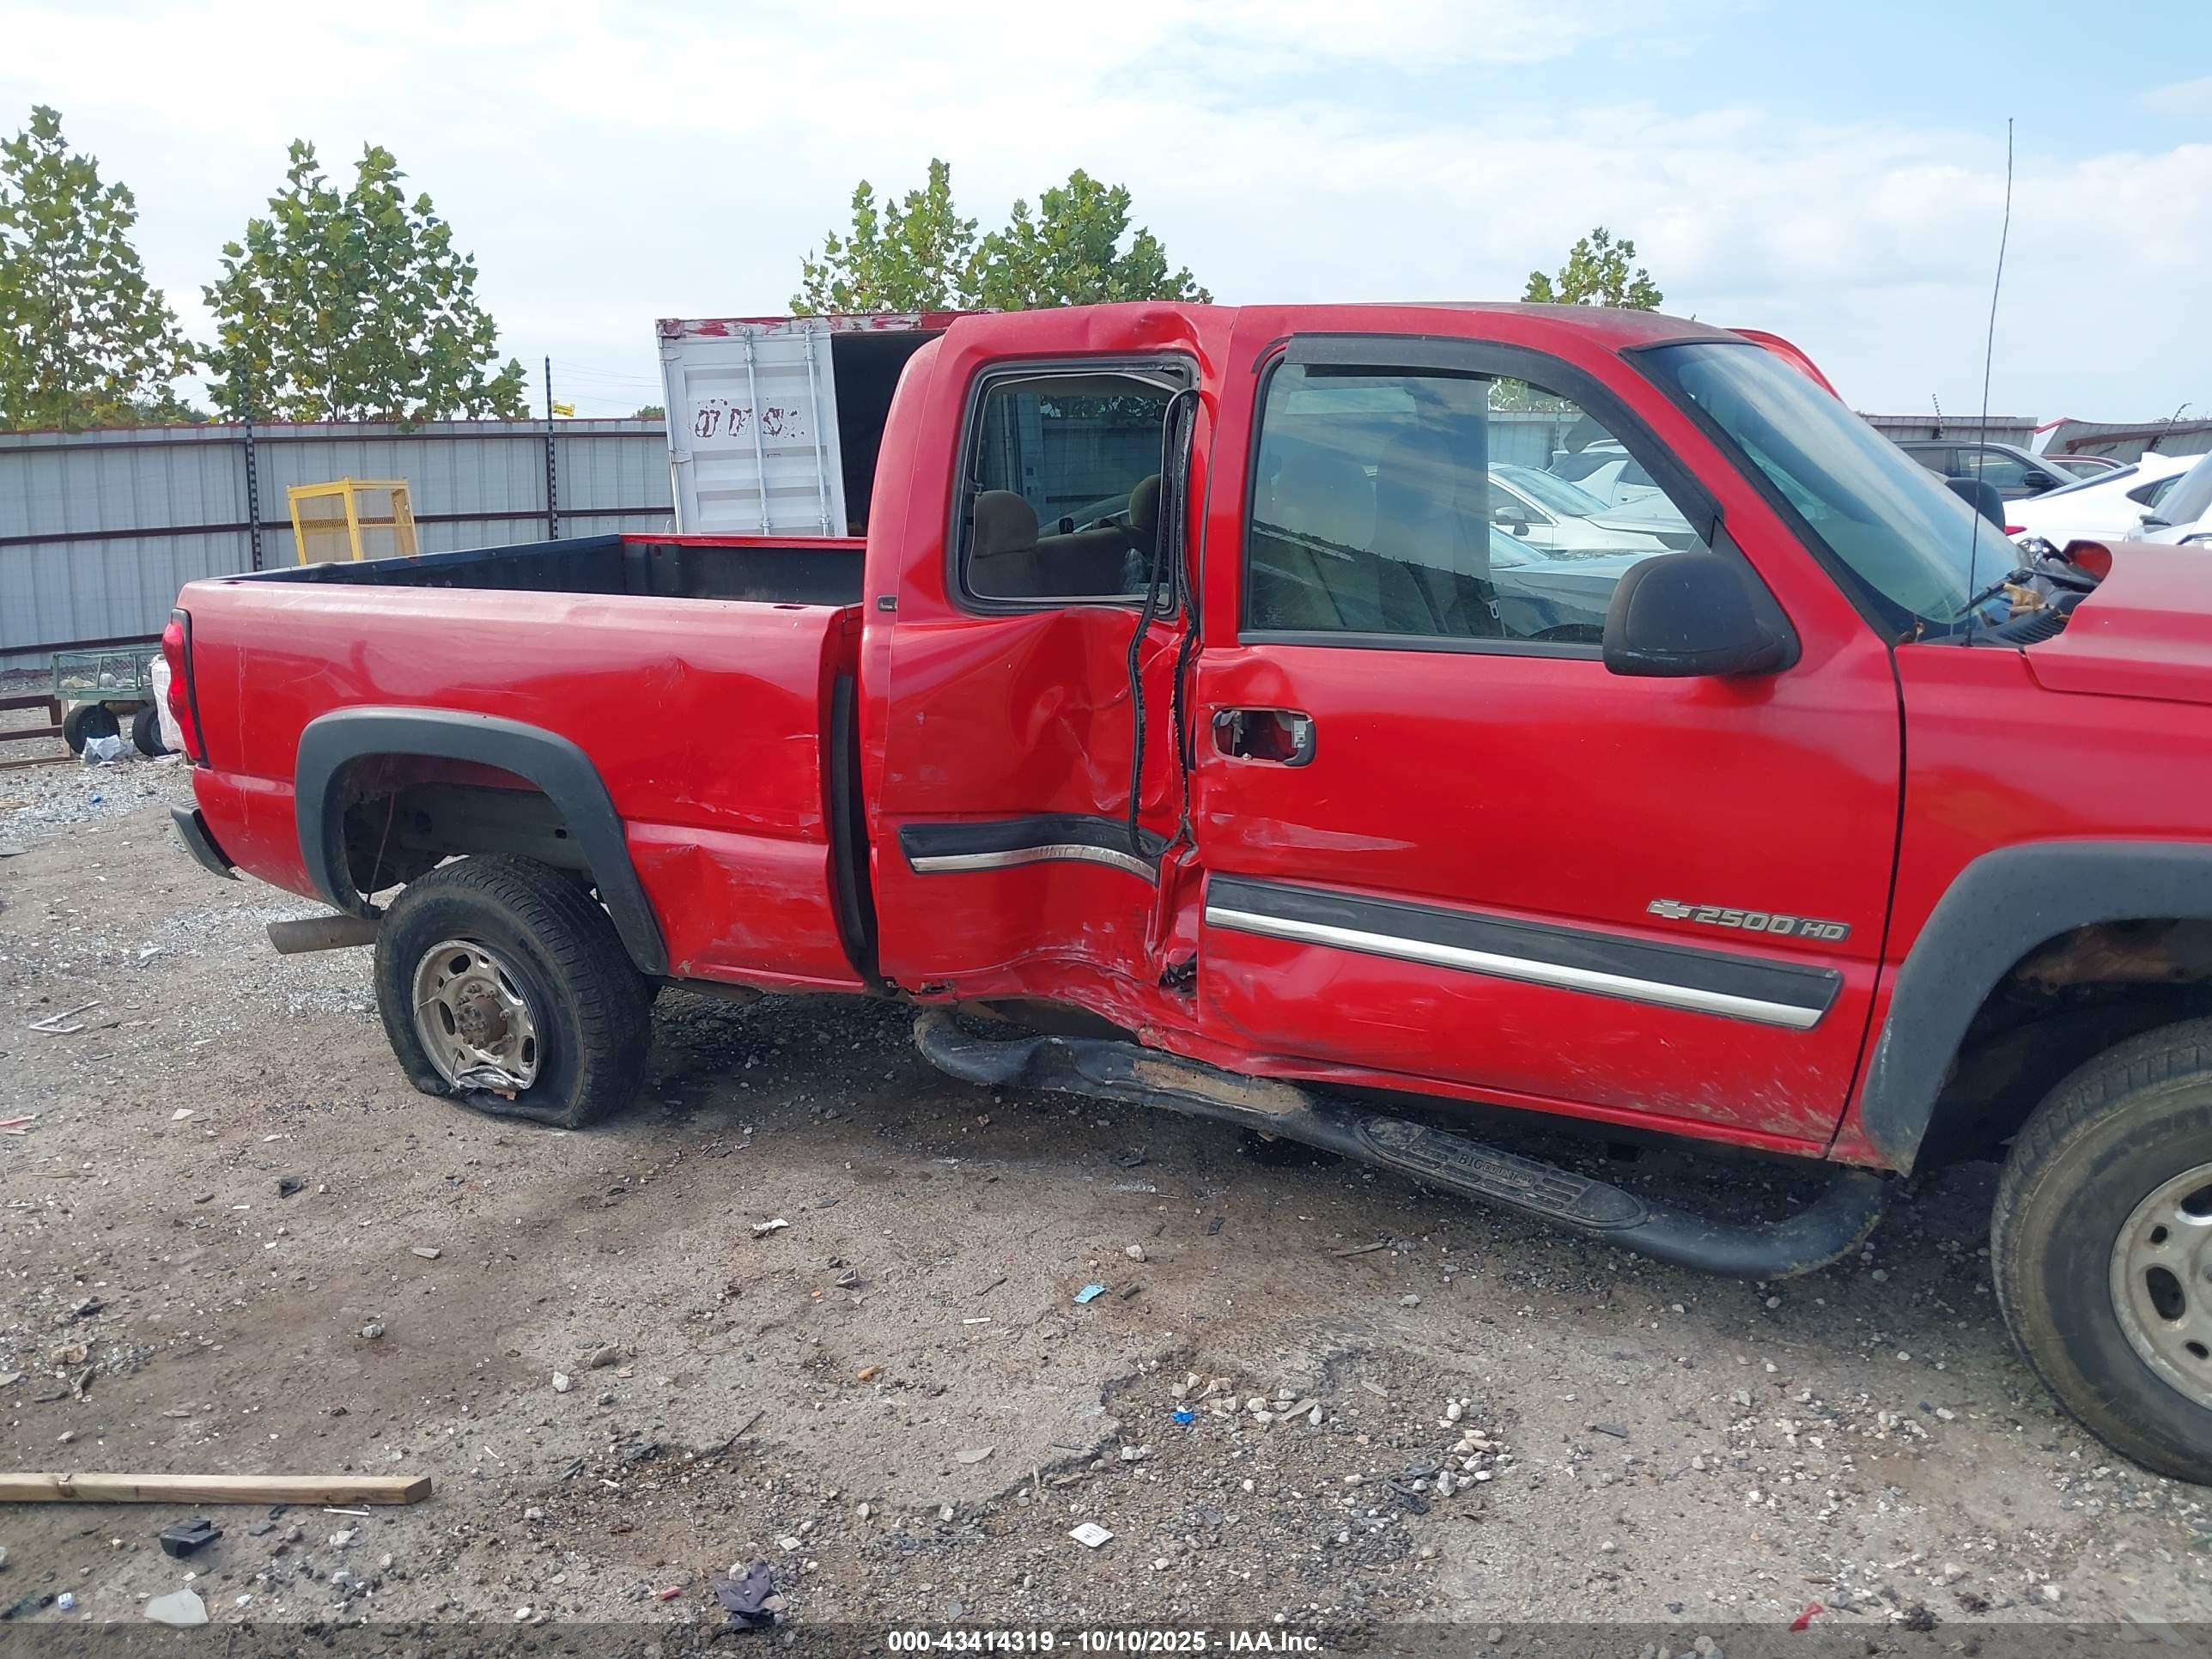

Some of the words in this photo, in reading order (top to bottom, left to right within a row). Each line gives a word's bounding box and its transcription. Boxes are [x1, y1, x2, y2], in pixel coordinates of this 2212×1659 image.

[1696, 908, 1796, 934] 2500
[1800, 923, 1845, 940] HD
[1457, 1153, 1485, 1170] BIG
